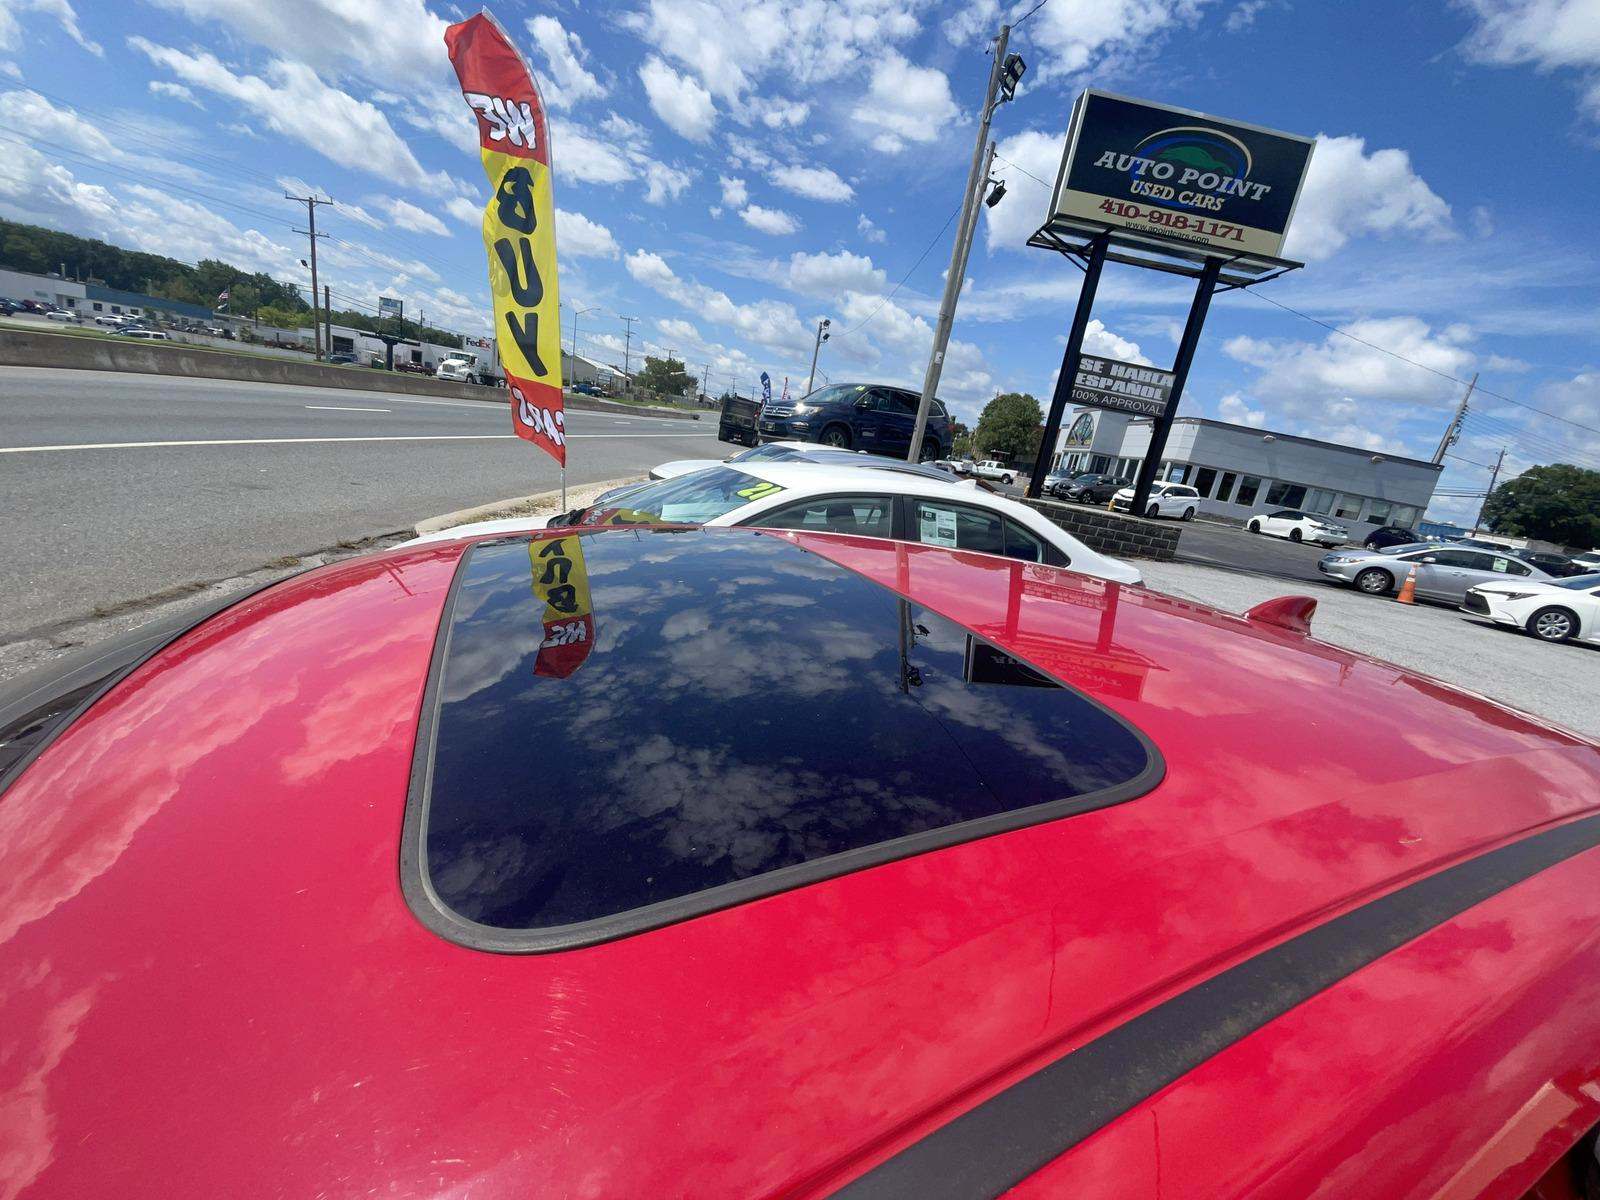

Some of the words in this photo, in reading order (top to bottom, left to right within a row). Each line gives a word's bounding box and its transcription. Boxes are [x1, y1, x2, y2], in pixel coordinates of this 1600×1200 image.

[1094, 150, 1175, 180] AUTO
[1178, 168, 1271, 201] POINT
[1130, 180, 1174, 200] USED
[1178, 191, 1225, 211] CARS
[1099, 198, 1245, 242] 410-918-1171
[466, 337, 490, 349] FedEx
[1080, 358, 1105, 373] SE
[1110, 363, 1175, 387] HABLA
[1071, 389, 1099, 403] 100%
[1101, 395, 1161, 415] APPROVAL
